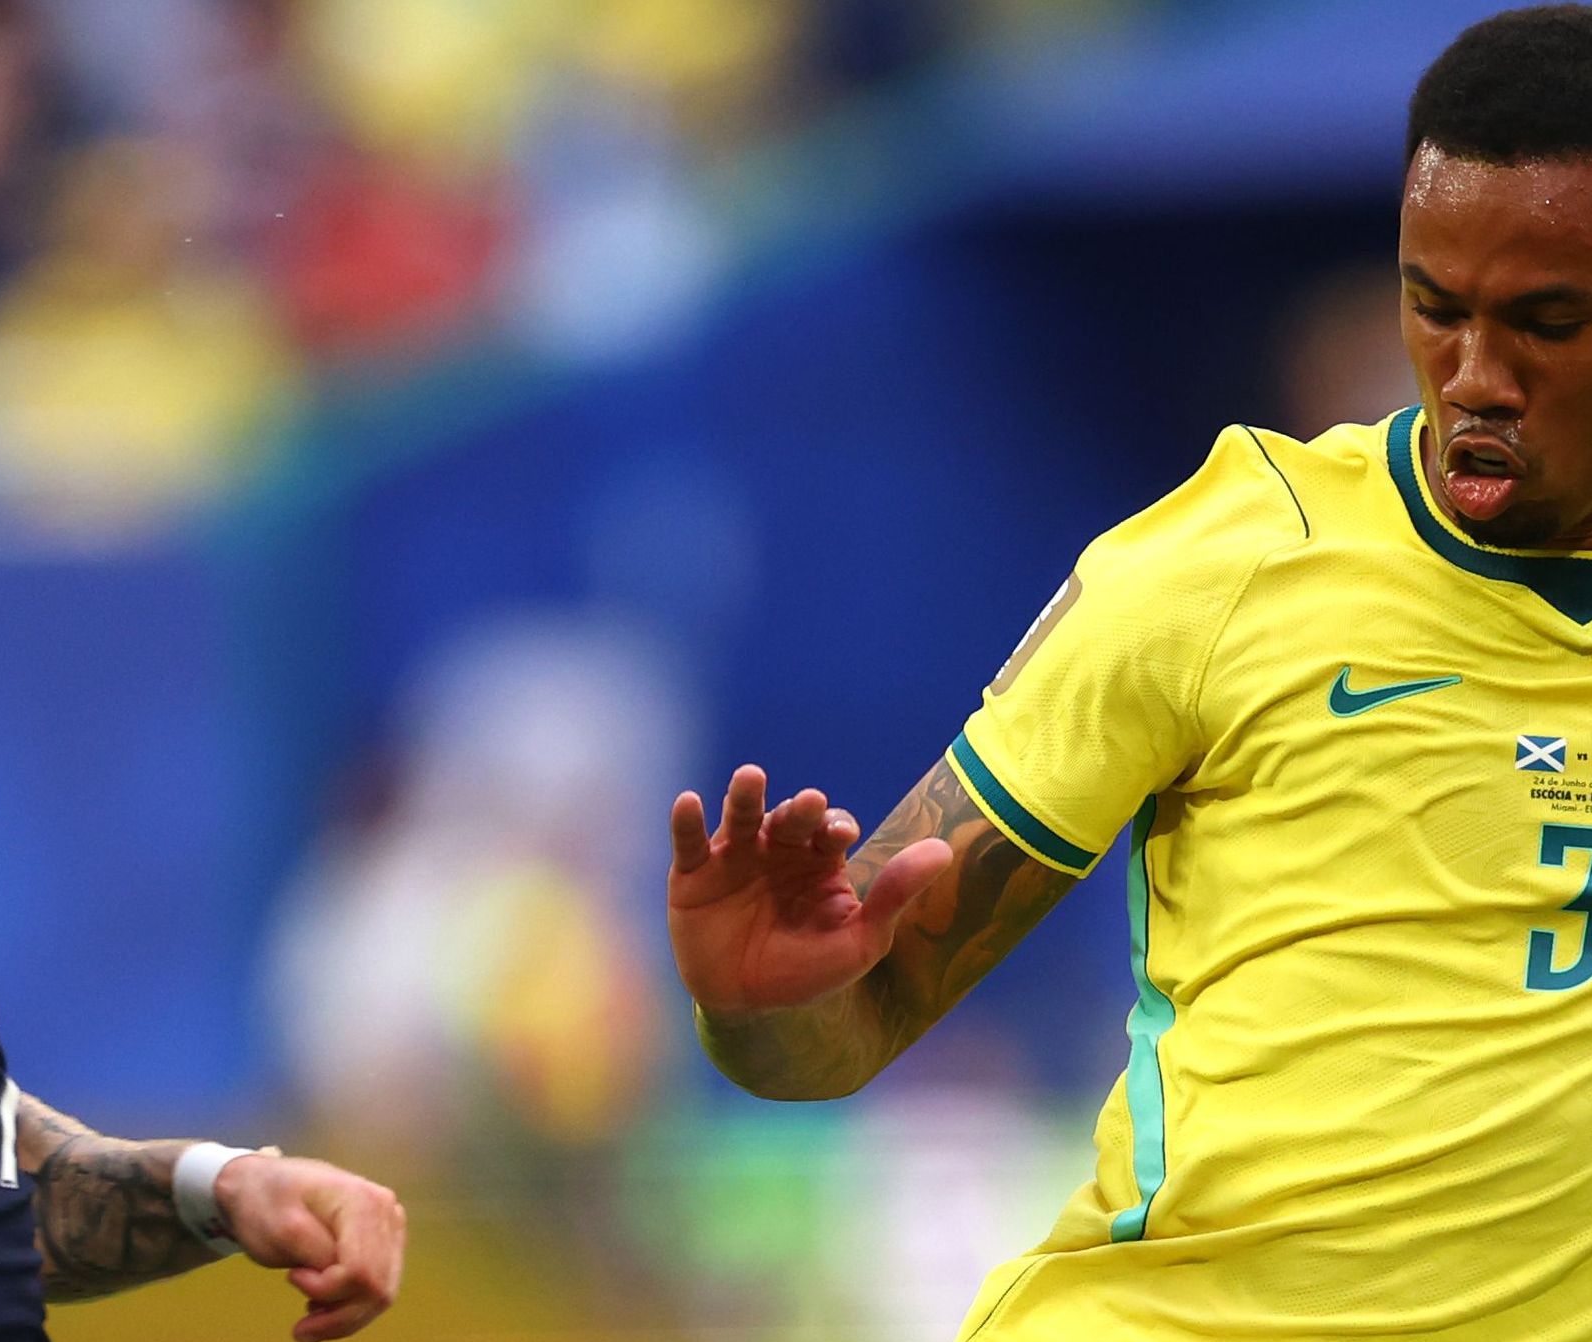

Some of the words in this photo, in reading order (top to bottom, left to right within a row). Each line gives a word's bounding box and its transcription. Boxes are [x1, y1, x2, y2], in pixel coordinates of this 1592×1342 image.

[1577, 753, 1588, 761] vs
[1533, 776, 1545, 785] 24
[1547, 777, 1558, 786] de
[1561, 778, 1586, 788] Junho
[1531, 787, 1572, 801] ESCÓCIA
[1575, 793, 1587, 802] vs
[1551, 803, 1577, 812] Miami
